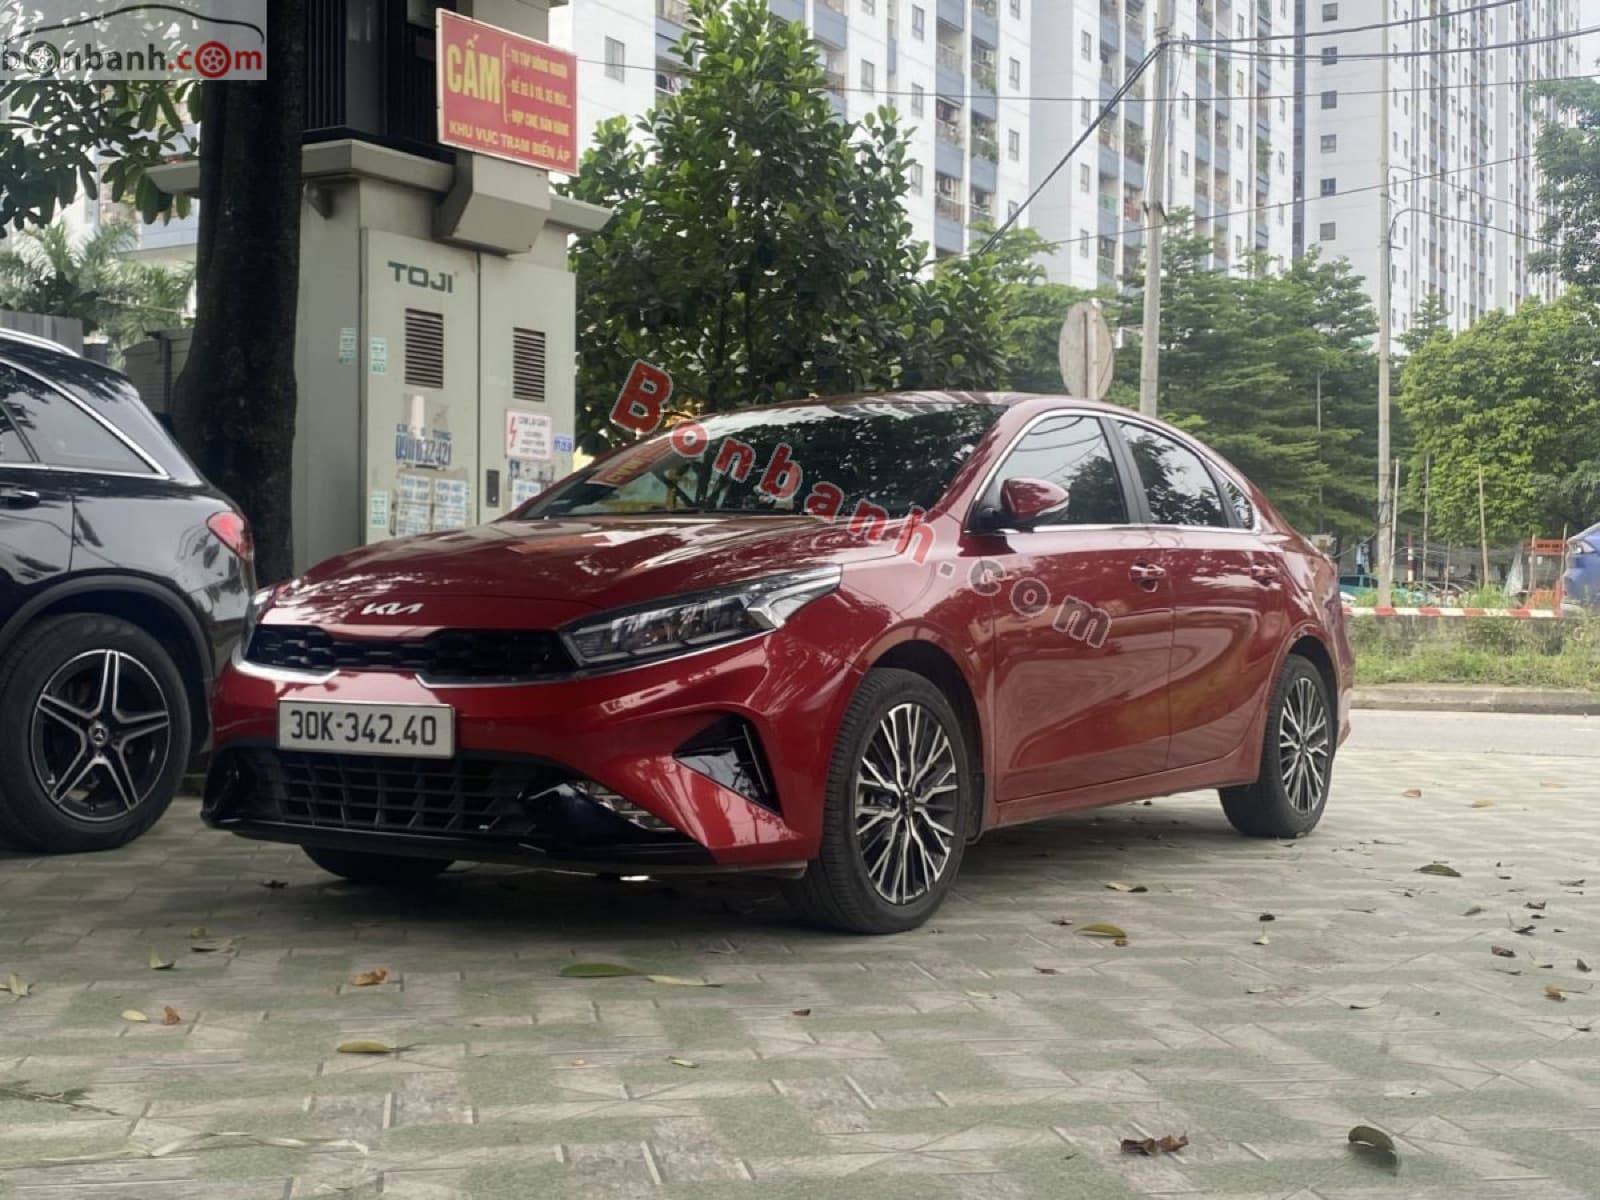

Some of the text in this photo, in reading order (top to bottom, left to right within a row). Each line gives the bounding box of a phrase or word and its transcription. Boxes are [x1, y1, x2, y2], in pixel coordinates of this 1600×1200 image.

[447, 34, 500, 104] CẤM
[448, 120, 473, 138] KHU
[475, 126, 499, 147] VỰC
[387, 260, 453, 293] TOJI
[360, 603, 424, 616] KIA
[289, 709, 437, 746] 30K-342.40
